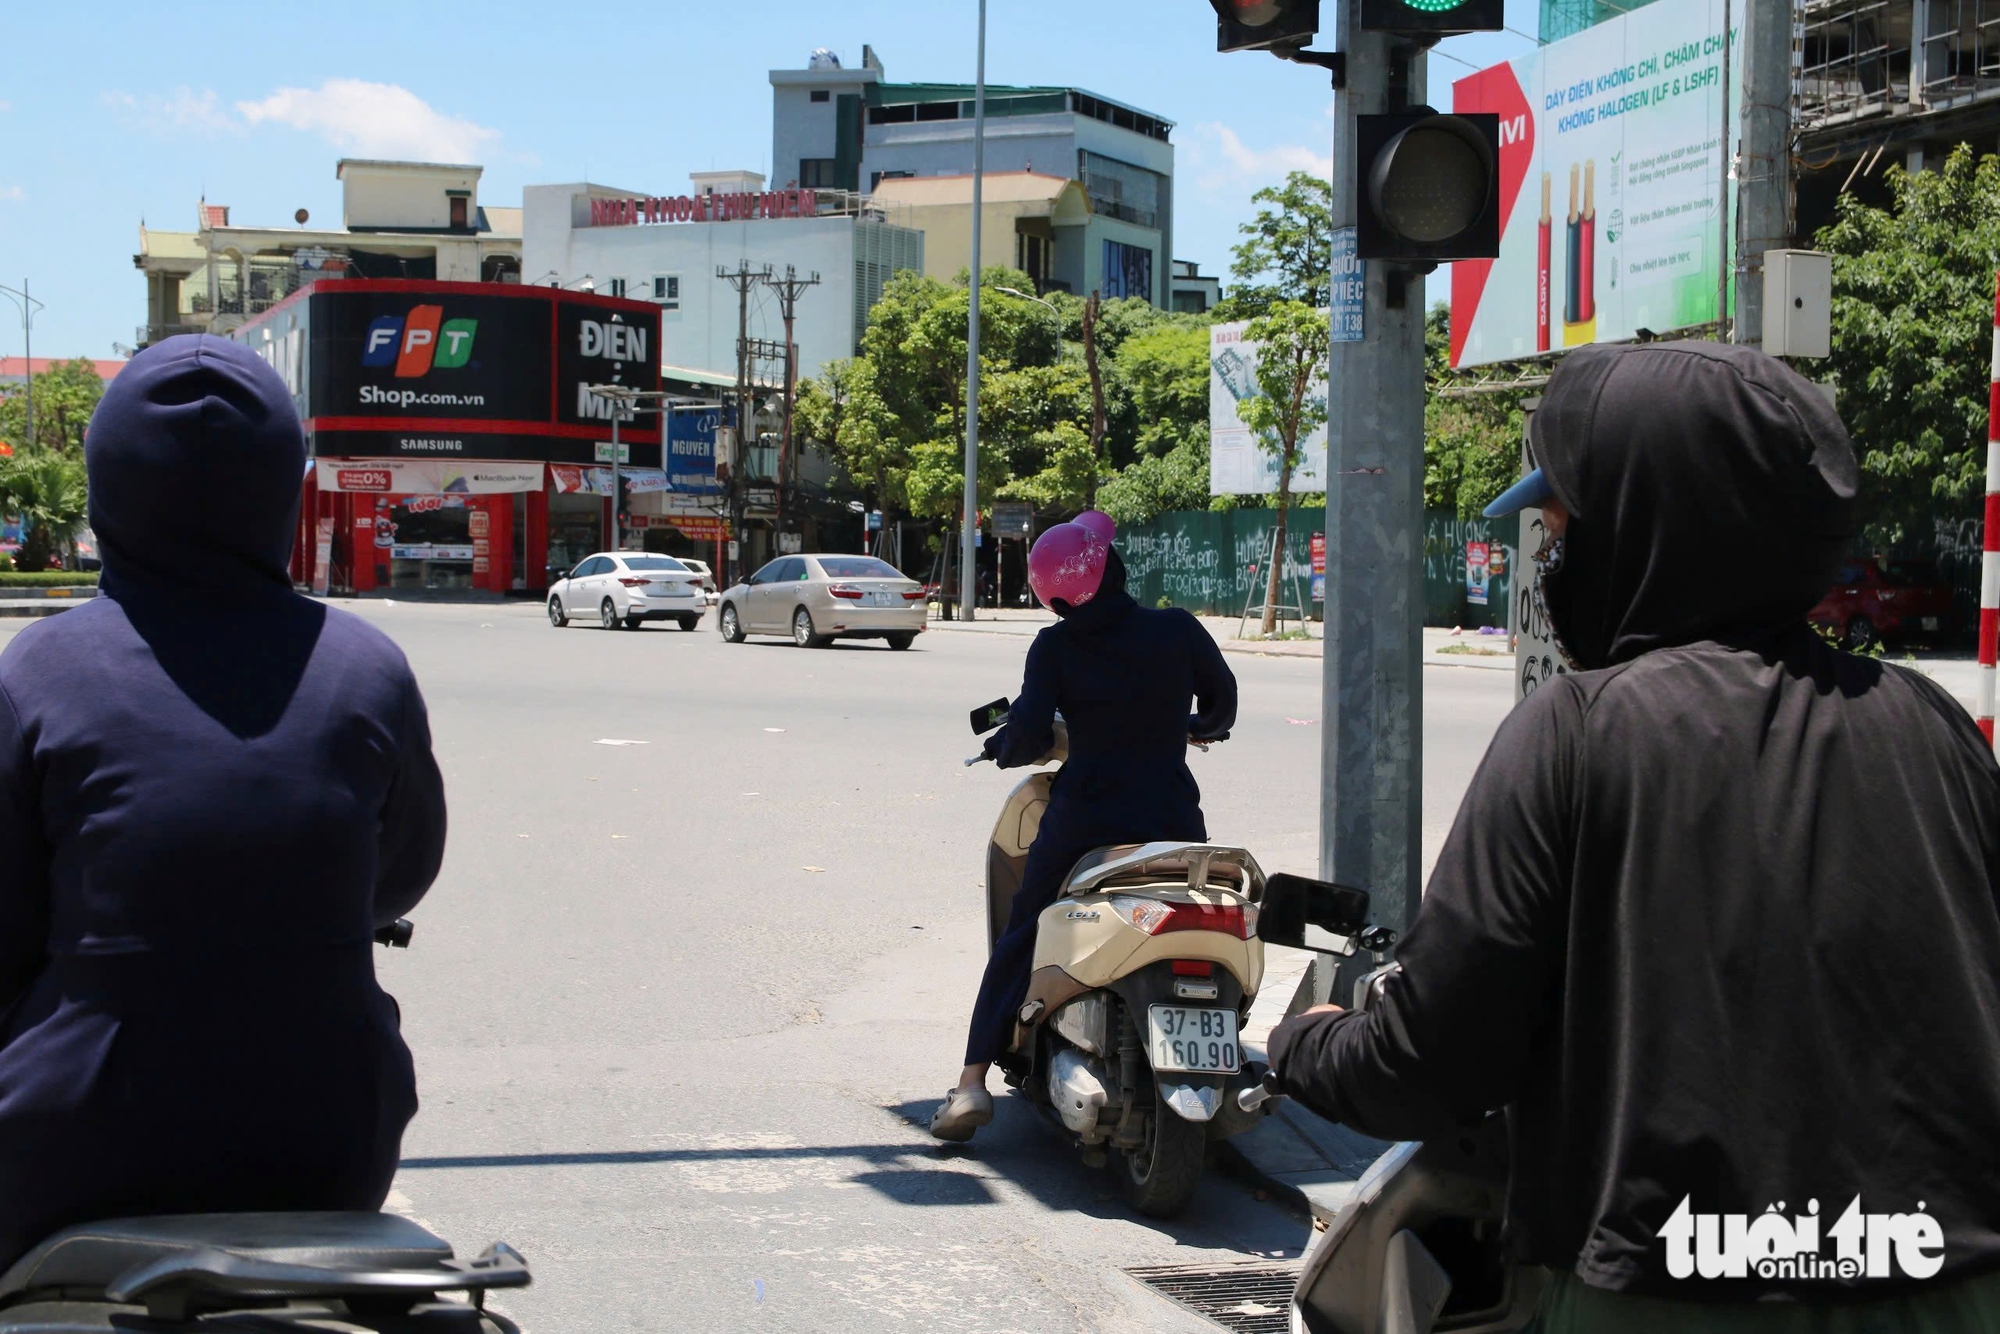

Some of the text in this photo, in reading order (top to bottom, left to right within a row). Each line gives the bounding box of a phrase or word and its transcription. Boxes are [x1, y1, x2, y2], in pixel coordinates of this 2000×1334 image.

[1545, 88, 1567, 111] DÂY
[1568, 79, 1593, 103] ĐIỆN
[1596, 66, 1635, 93] KHÔNG
[1638, 53, 1660, 79] CHÌ,
[1664, 42, 1700, 69] CHẬM
[1558, 66, 1719, 134] KHÔNG HALOGEN (LF & LSHF)
[644, 195, 705, 224] KHOA
[713, 192, 752, 221] THU
[1340, 277, 1364, 305] VIỆC
[1345, 315, 1363, 332] 138
[579, 314, 647, 370] ĐIỆN
[359, 385, 485, 408] Shop.com.vn
[400, 438, 463, 451] SAMSUNG
[597, 446, 626, 459] Kangoo
[363, 472, 387, 485] 0%
[1163, 1009, 1225, 1038] 37-B3
[1159, 1040, 1235, 1069] 160.90
